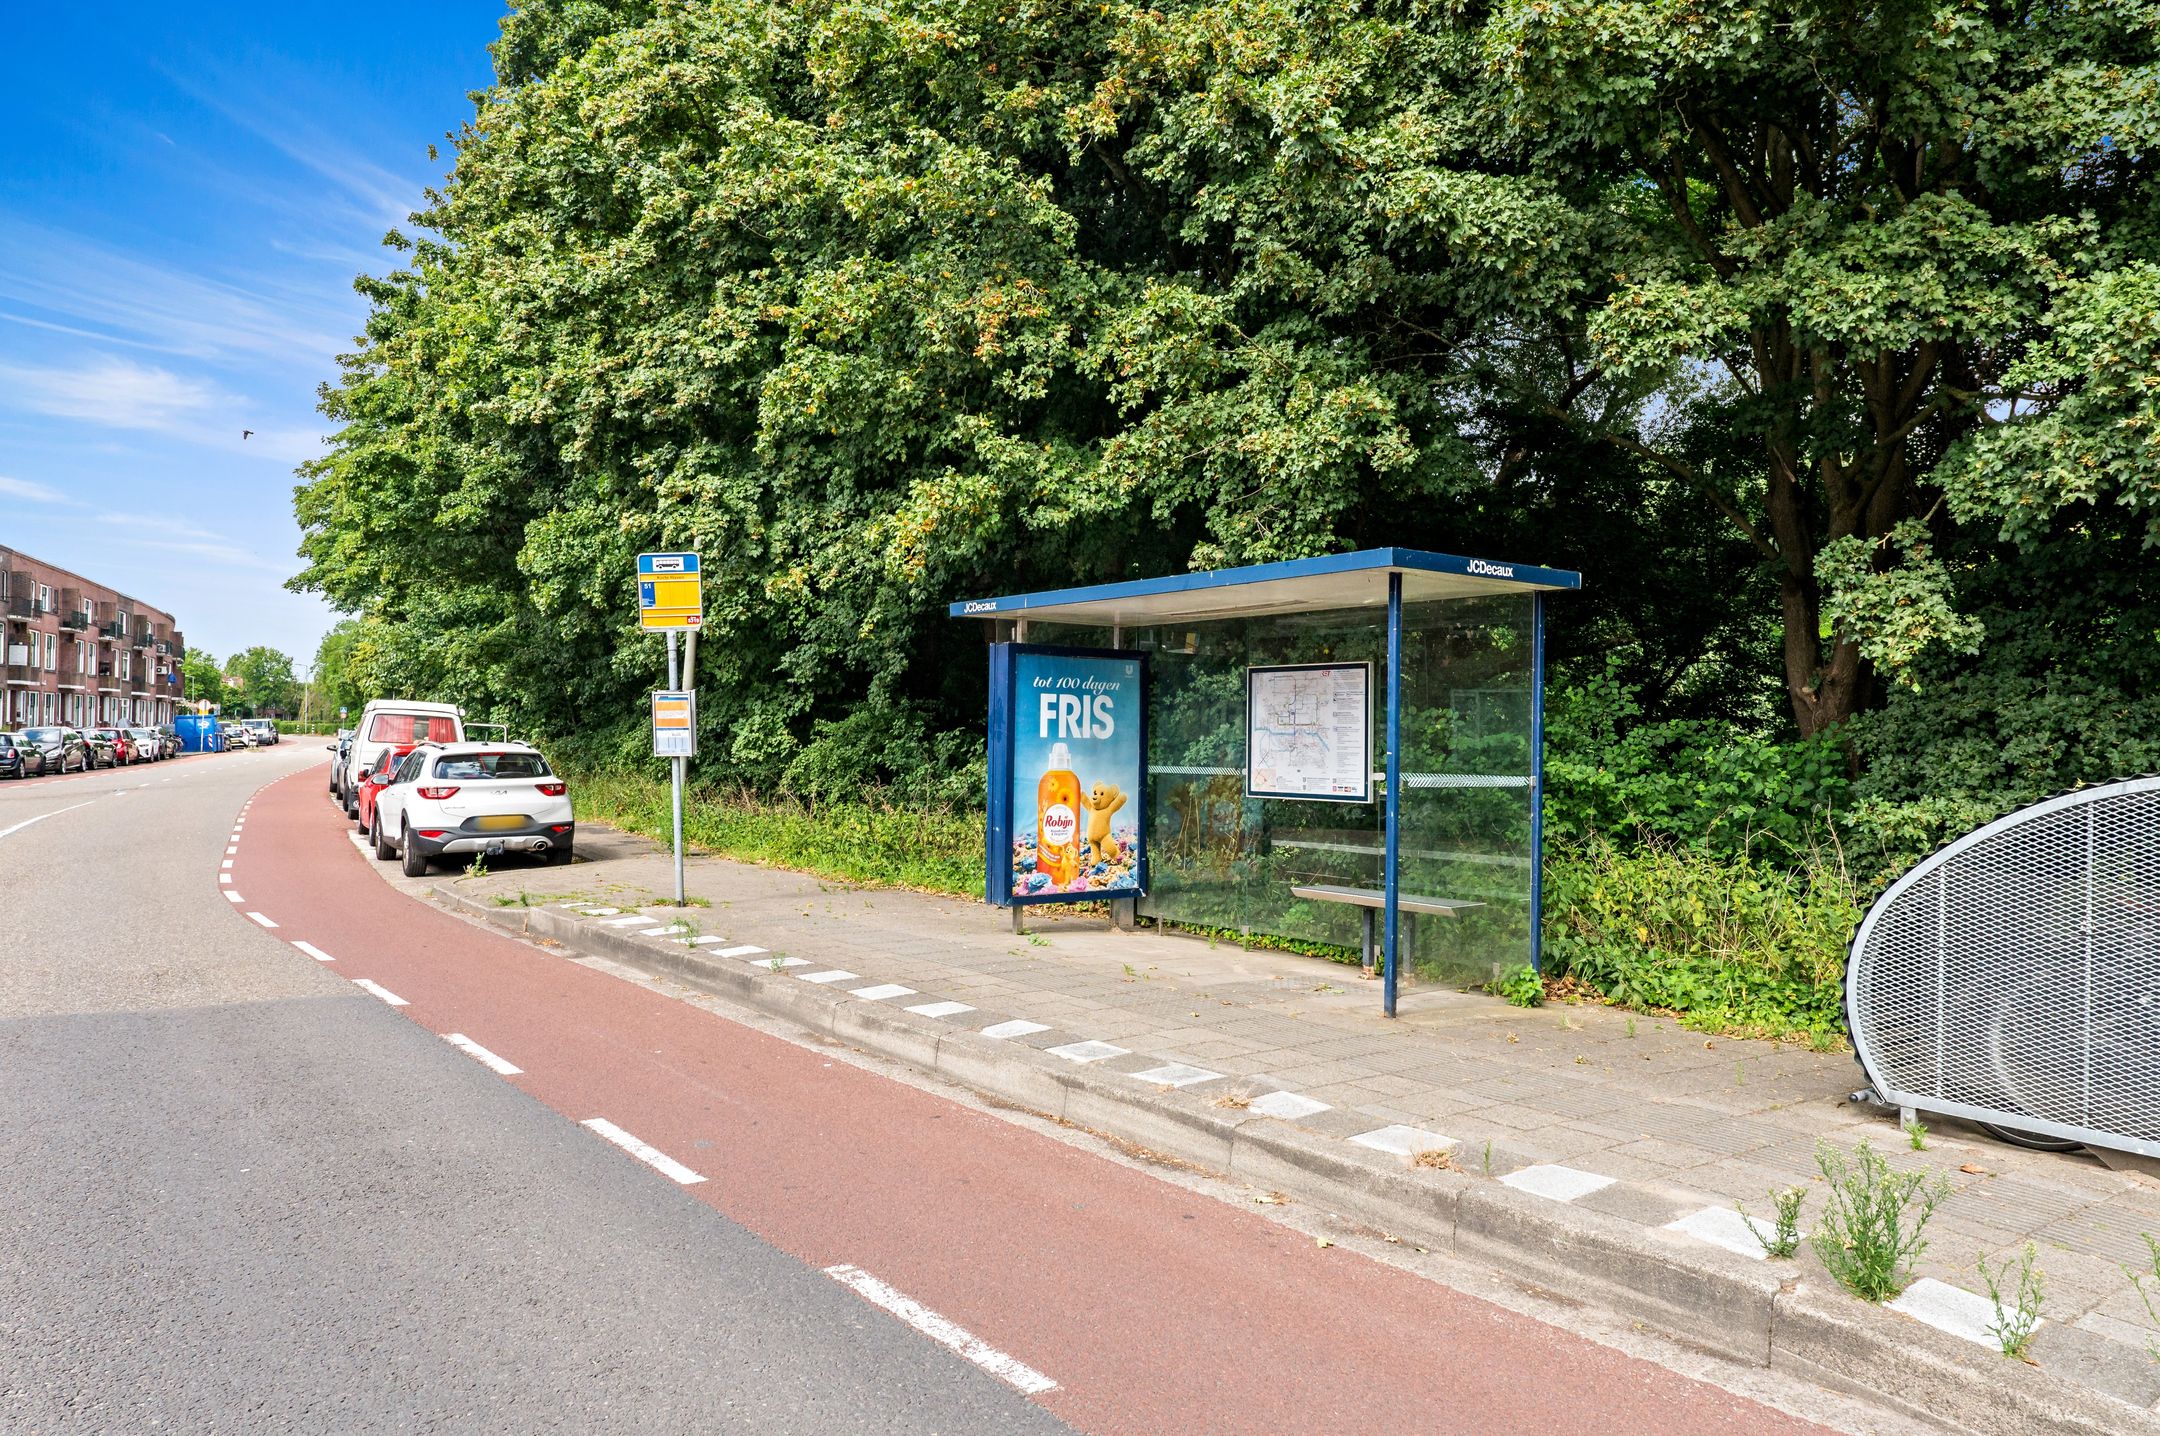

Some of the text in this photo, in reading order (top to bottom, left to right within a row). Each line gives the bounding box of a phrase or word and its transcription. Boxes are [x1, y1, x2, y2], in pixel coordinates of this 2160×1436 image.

[1467, 559, 1514, 578] JCDecaux
[963, 601, 997, 614] JCDecaux
[1033, 675, 1120, 696] tot 100 dagen
[1039, 693, 1115, 740] FRIS
[1045, 815, 1074, 830] Robijn
